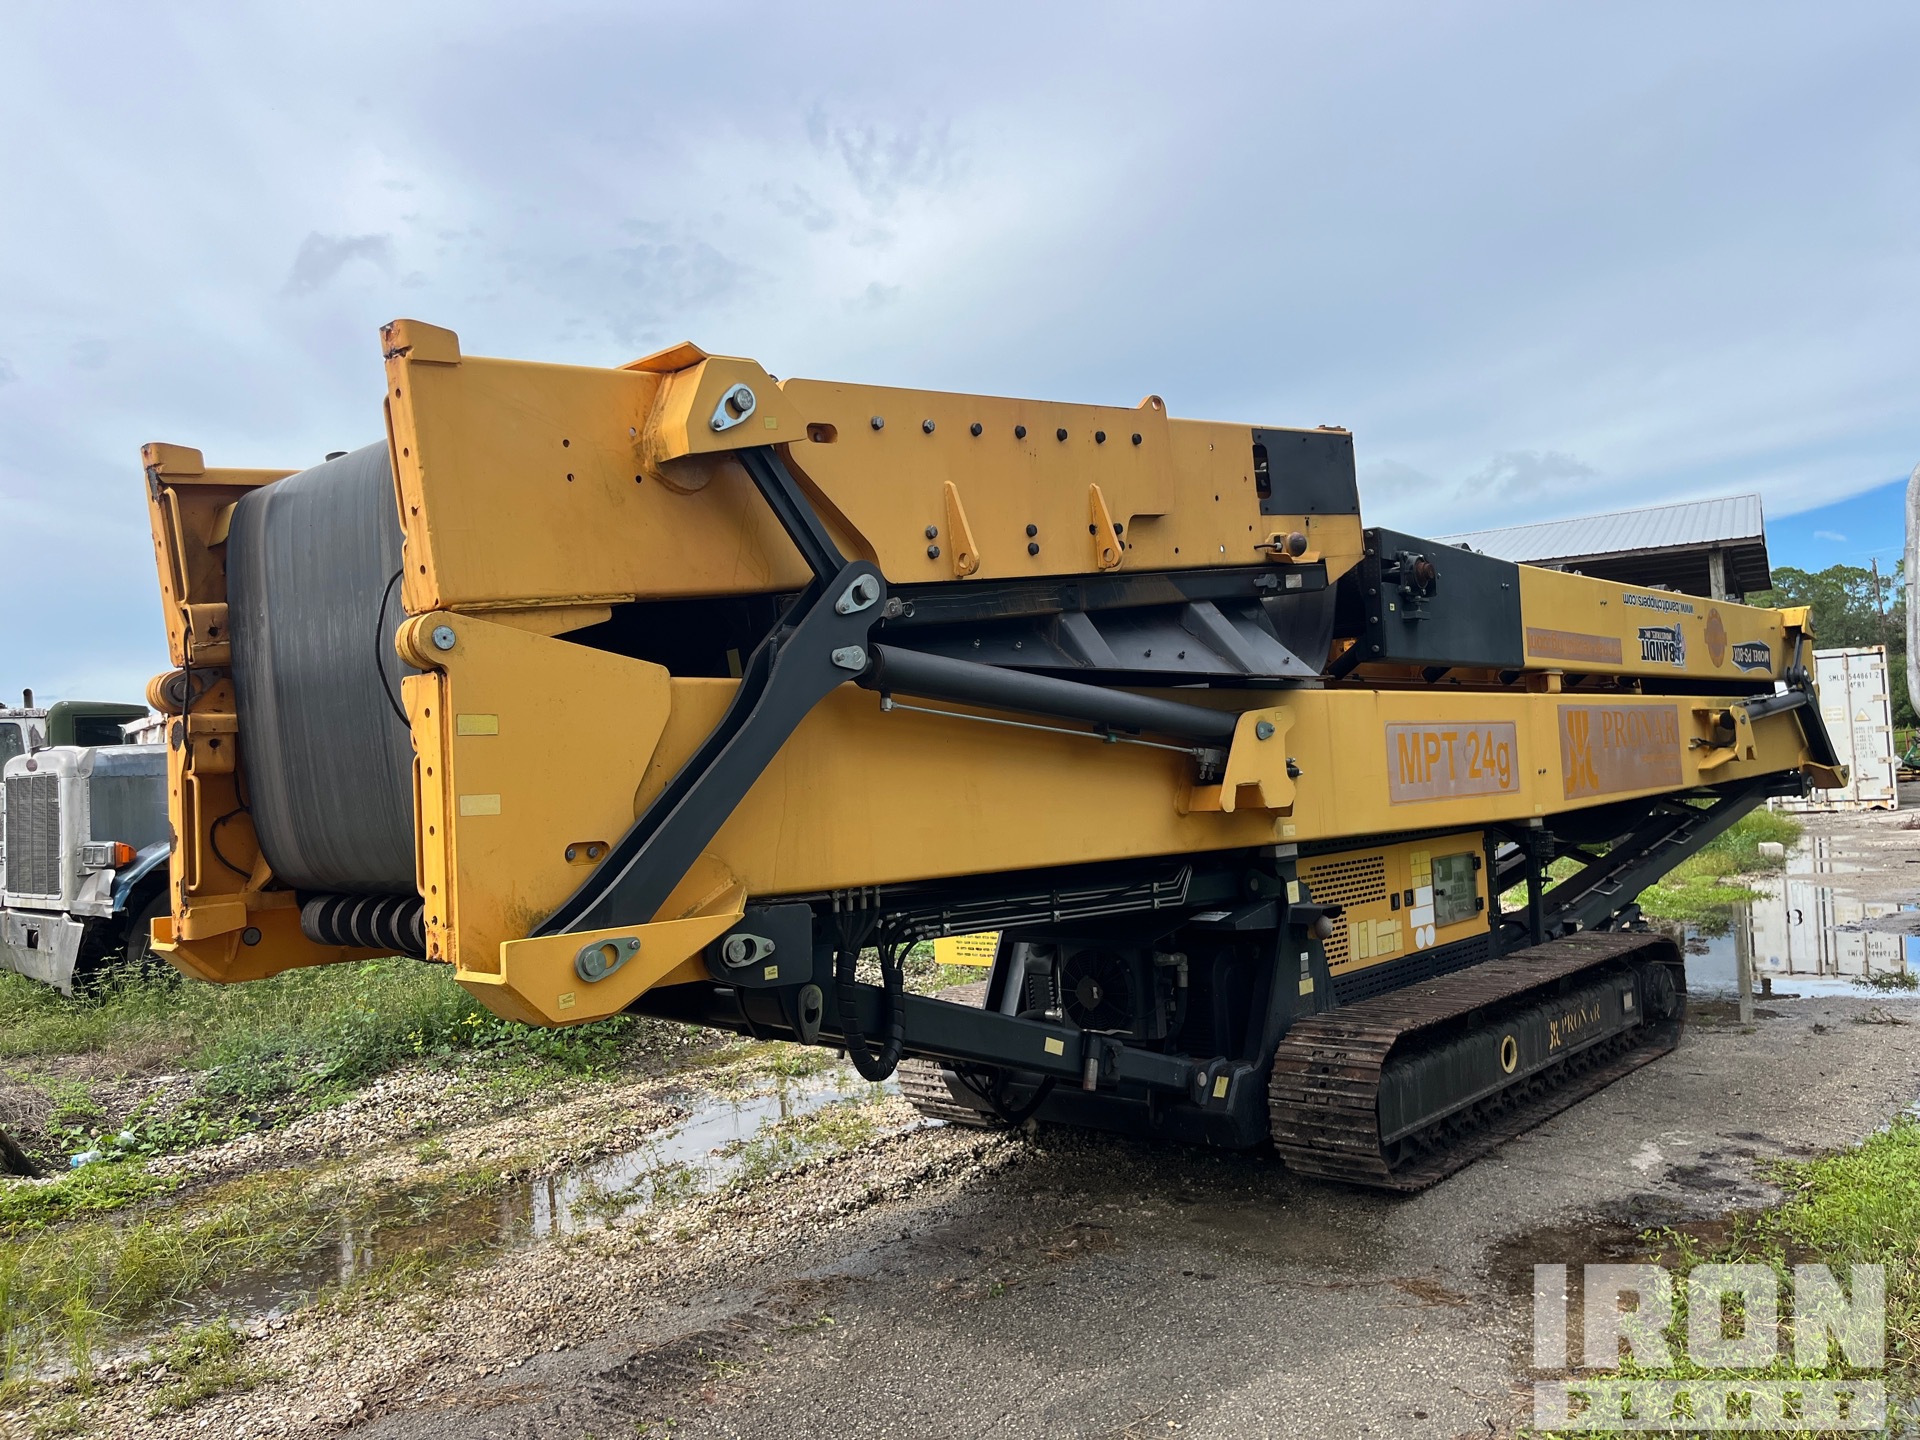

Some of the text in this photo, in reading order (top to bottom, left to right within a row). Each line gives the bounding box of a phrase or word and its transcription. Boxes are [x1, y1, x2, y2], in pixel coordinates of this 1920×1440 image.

[1622, 593, 1695, 615] www.banditchippers.com
[1641, 639, 1676, 662] BANDIT
[1752, 649, 1770, 663] MODEL
[1601, 710, 1678, 749] PRONAR
[1396, 730, 1510, 789] MPT 24g
[1561, 1002, 1600, 1035] PRONAR
